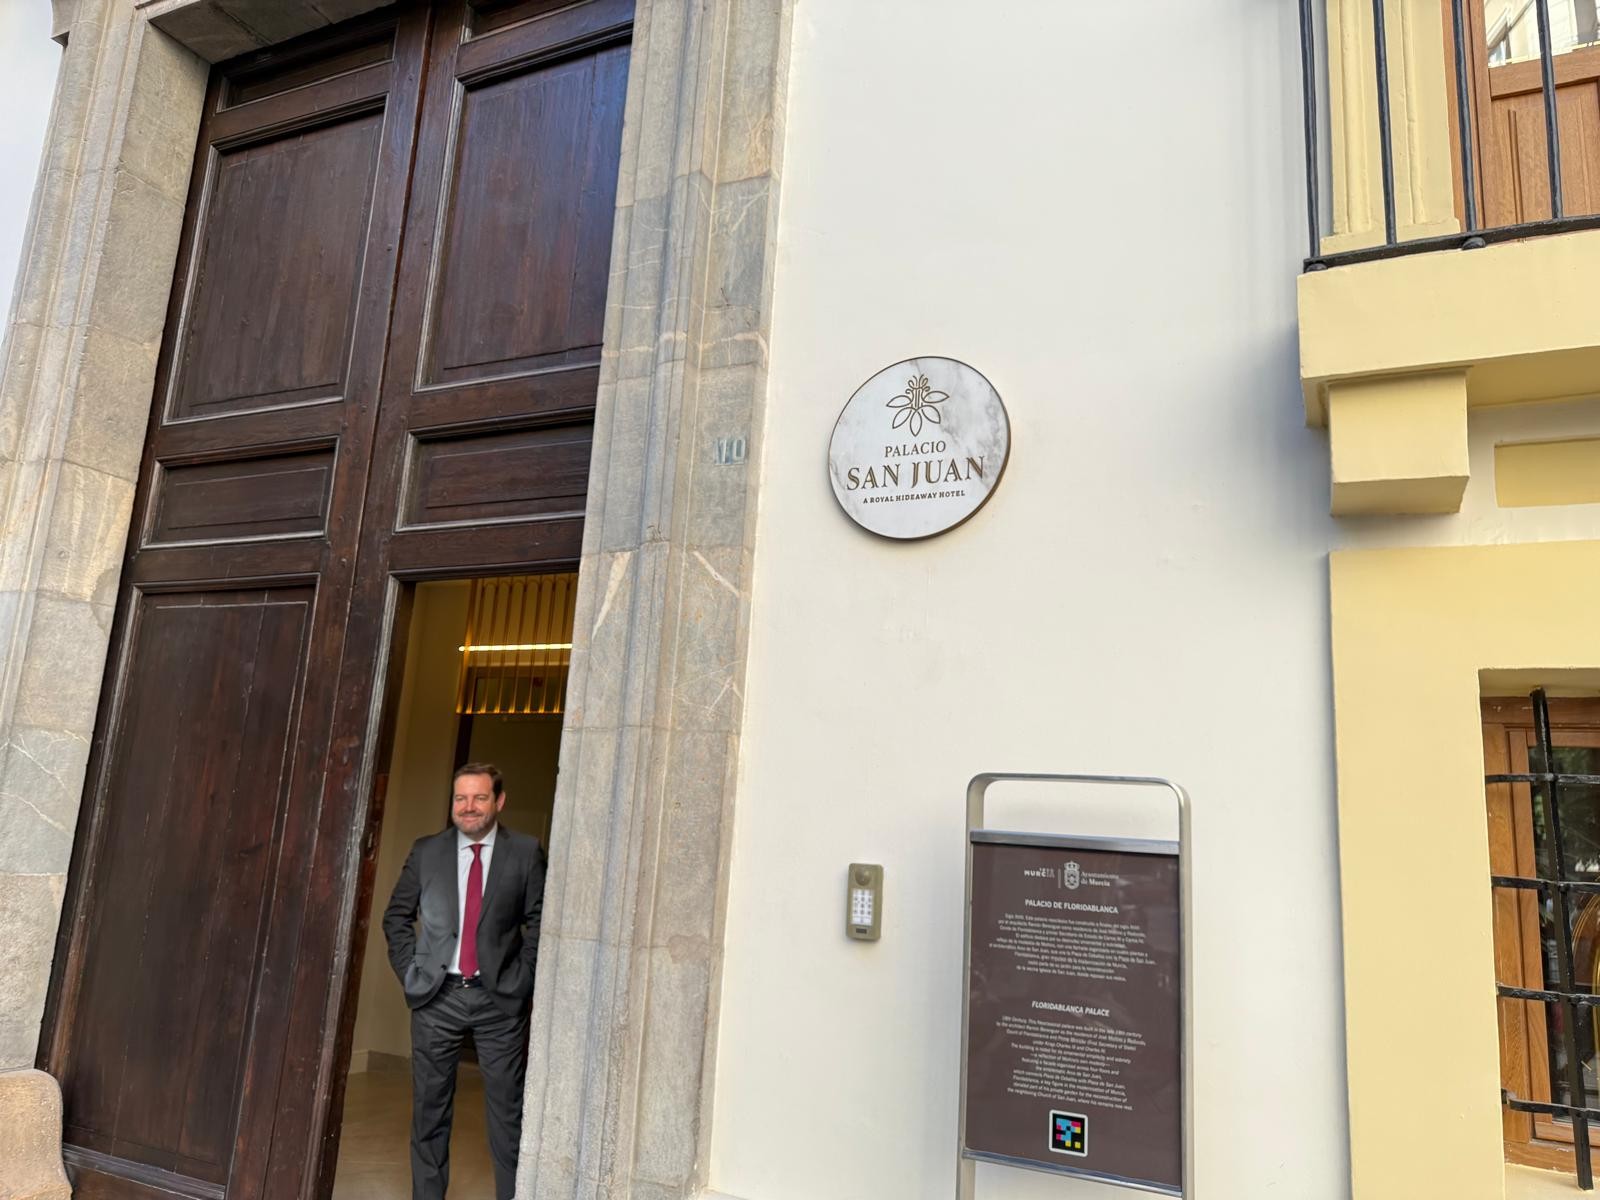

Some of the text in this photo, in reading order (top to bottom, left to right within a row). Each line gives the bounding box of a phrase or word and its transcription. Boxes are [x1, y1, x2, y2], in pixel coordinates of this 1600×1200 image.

[884, 441, 946, 457] PALACIO
[846, 456, 985, 490] SAN JUAN
[869, 496, 894, 504] ROYAL
[896, 492, 938, 502] HIDEAWAY
[939, 490, 966, 499] HOTEL
[1089, 879, 1111, 887] Murcia
[1025, 899, 1119, 914] PALACIO DE FLORIDABLANCA
[1031, 1000, 1110, 1017] FLORIDABLANCA PALACE
